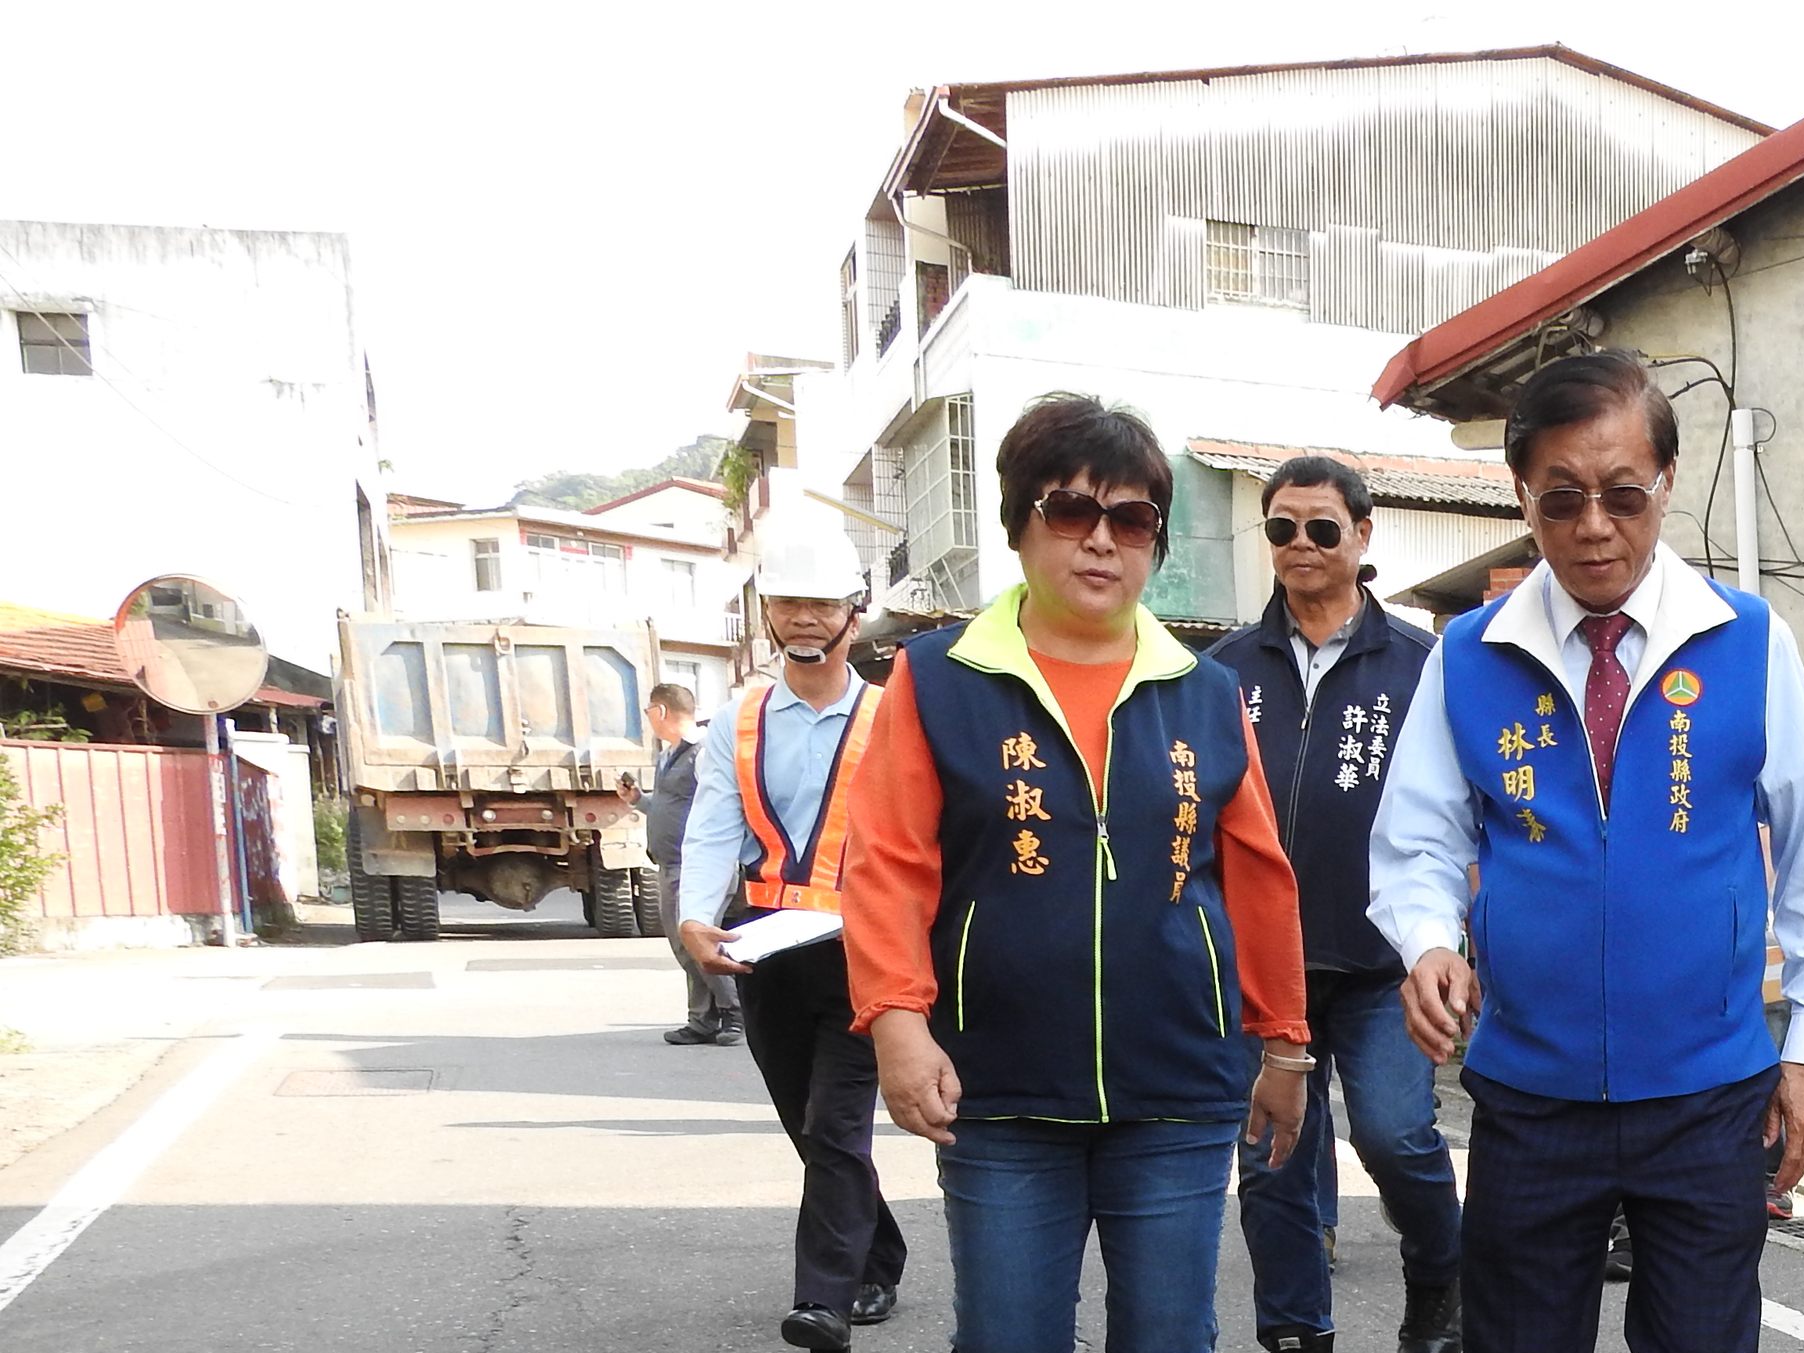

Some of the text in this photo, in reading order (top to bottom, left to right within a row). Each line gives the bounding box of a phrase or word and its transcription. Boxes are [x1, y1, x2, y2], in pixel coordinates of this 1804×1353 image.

[1335, 705, 1368, 792] 許淑華
[1365, 693, 1391, 781] 立法委員
[1536, 693, 1558, 748] 縣長
[1669, 710, 1693, 833] 南投縣政府
[1002, 732, 1052, 875] 陳淑惠
[1169, 740, 1202, 903] 南投縣議員
